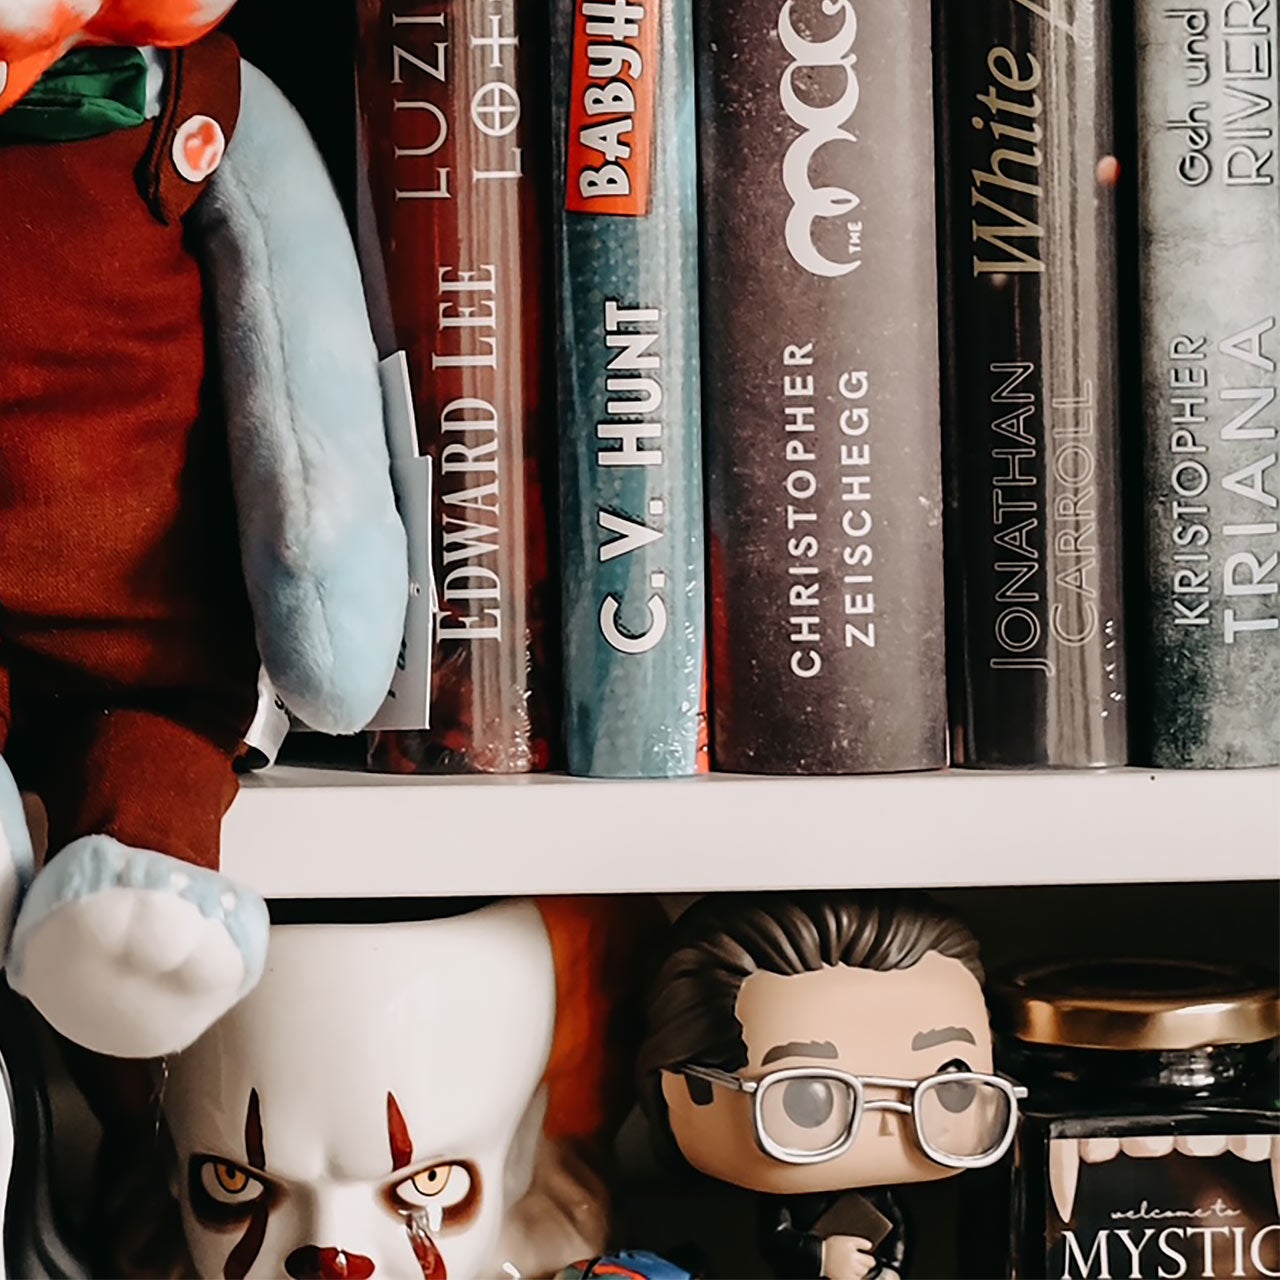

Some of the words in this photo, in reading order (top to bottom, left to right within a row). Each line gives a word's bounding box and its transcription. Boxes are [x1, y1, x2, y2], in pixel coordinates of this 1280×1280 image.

[970, 46, 1046, 278] White
[1164, 8, 1211, 88] und
[1166, 102, 1212, 187] Geh
[431, 263, 498, 373] LEE
[848, 220, 864, 255] THE
[596, 300, 664, 467] HUNT
[1170, 334, 1212, 628] KRISTOPHER
[1219, 316, 1280, 644] TRIANA
[435, 397, 503, 644] EDWARD
[599, 498, 666, 562] V.
[600, 571, 668, 655] C.
[783, 342, 821, 678] CHRISTOPHER
[838, 370, 876, 648] ZEISCHEGG
[990, 361, 1055, 677] JONATHAN
[1049, 378, 1098, 648] CARROLL
